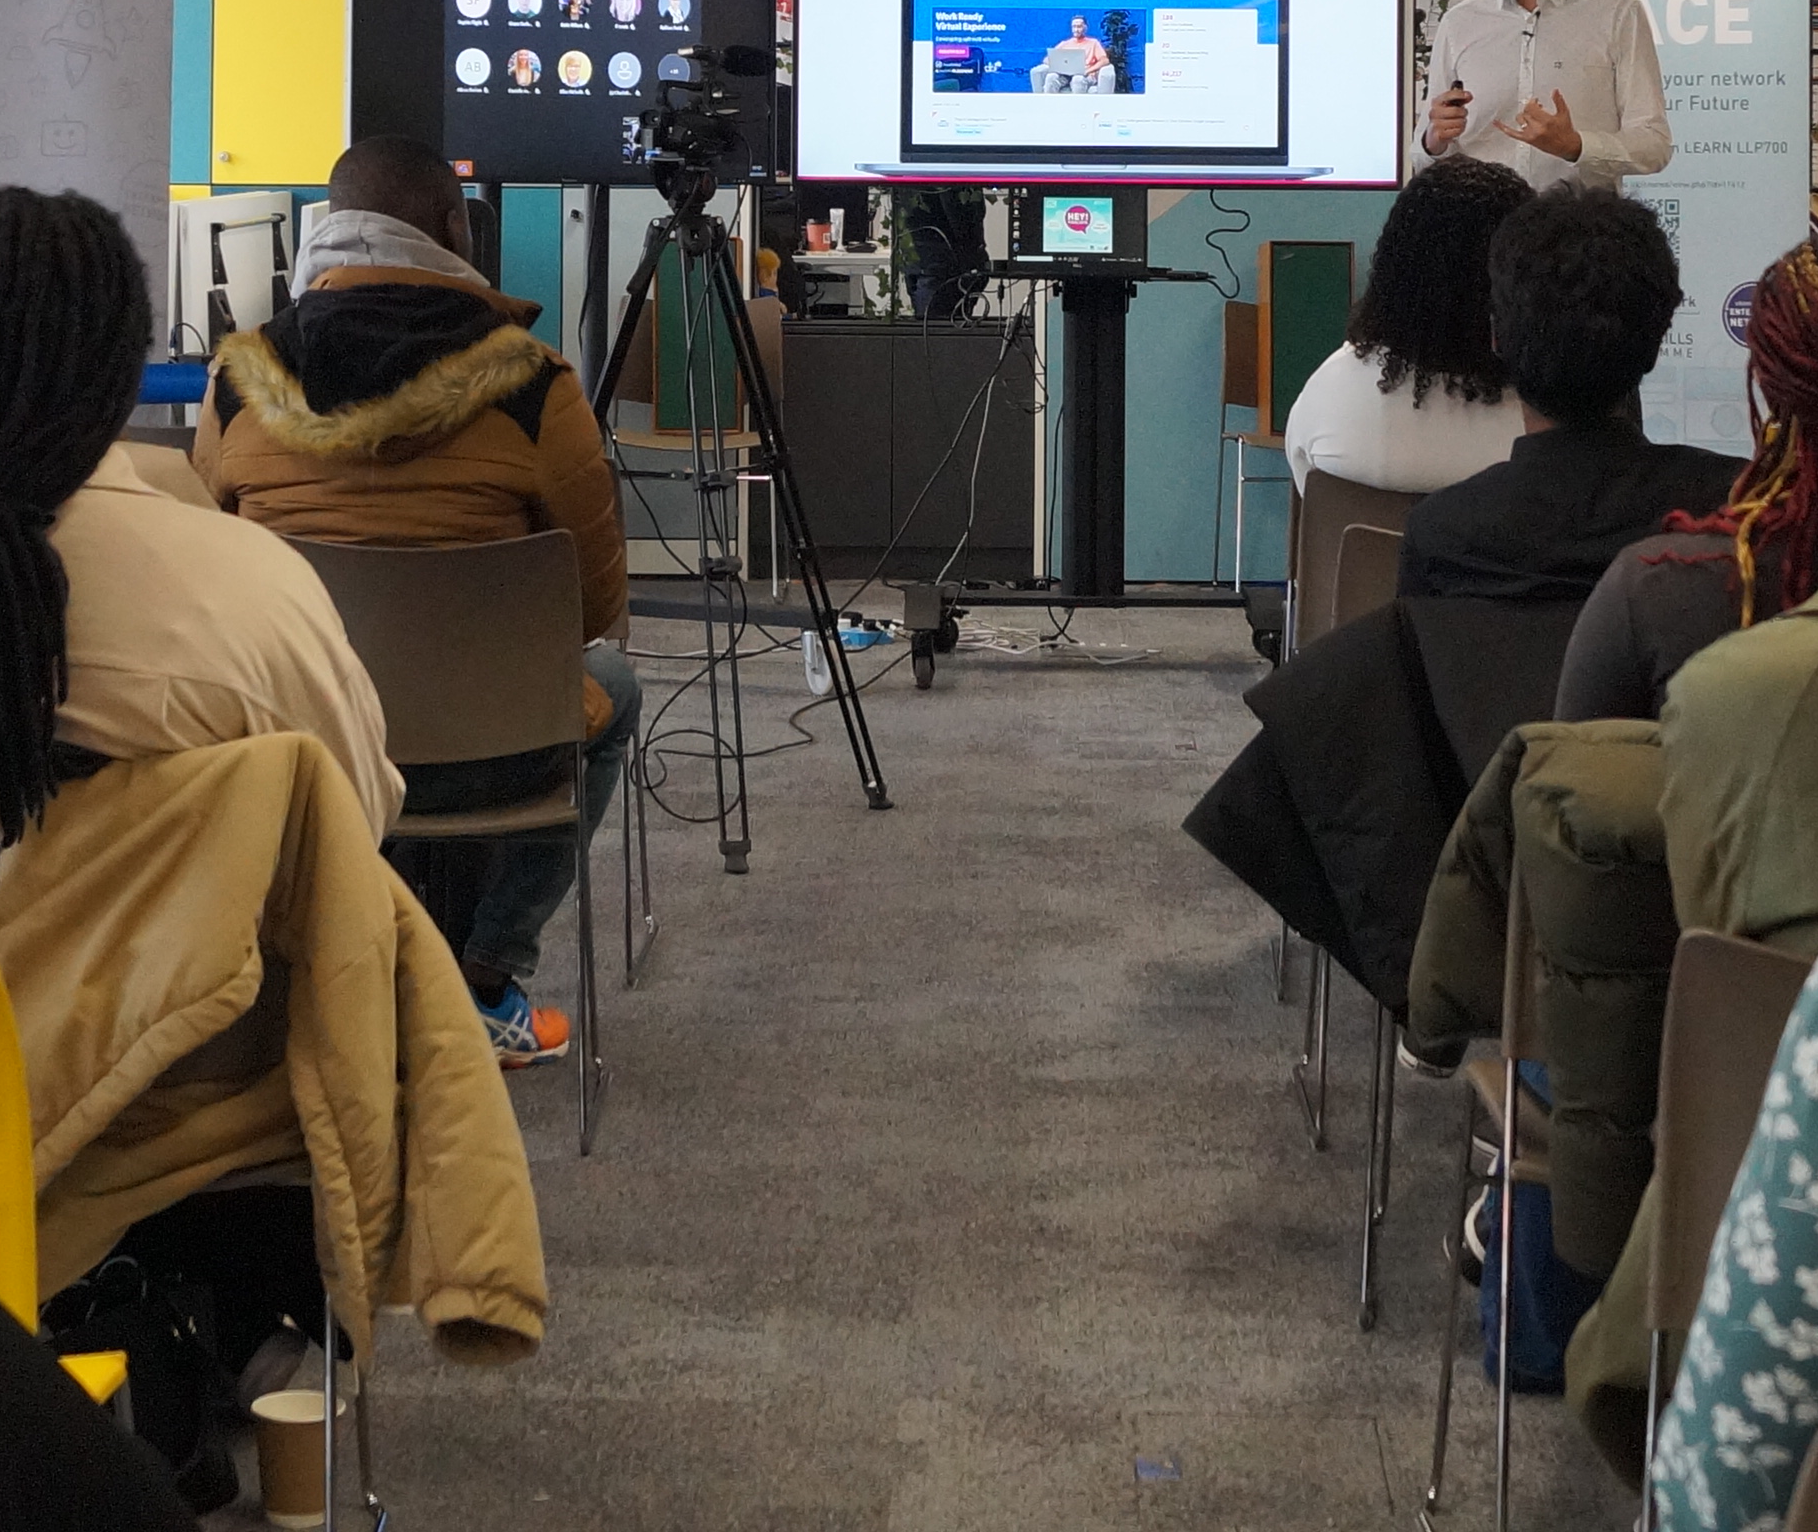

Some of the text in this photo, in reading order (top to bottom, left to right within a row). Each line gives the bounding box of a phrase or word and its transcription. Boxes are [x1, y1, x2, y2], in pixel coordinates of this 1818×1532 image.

[935, 12, 984, 22] Work Ready
[935, 21, 1006, 32] Virtual Experience
[464, 62, 482, 73] AB
[1663, 70, 1786, 90] your network
[1689, 95, 1750, 111] Future
[1684, 142, 1731, 154] LEARN
[1737, 142, 1788, 154] LLP700
[1067, 212, 1088, 221] HEY!
